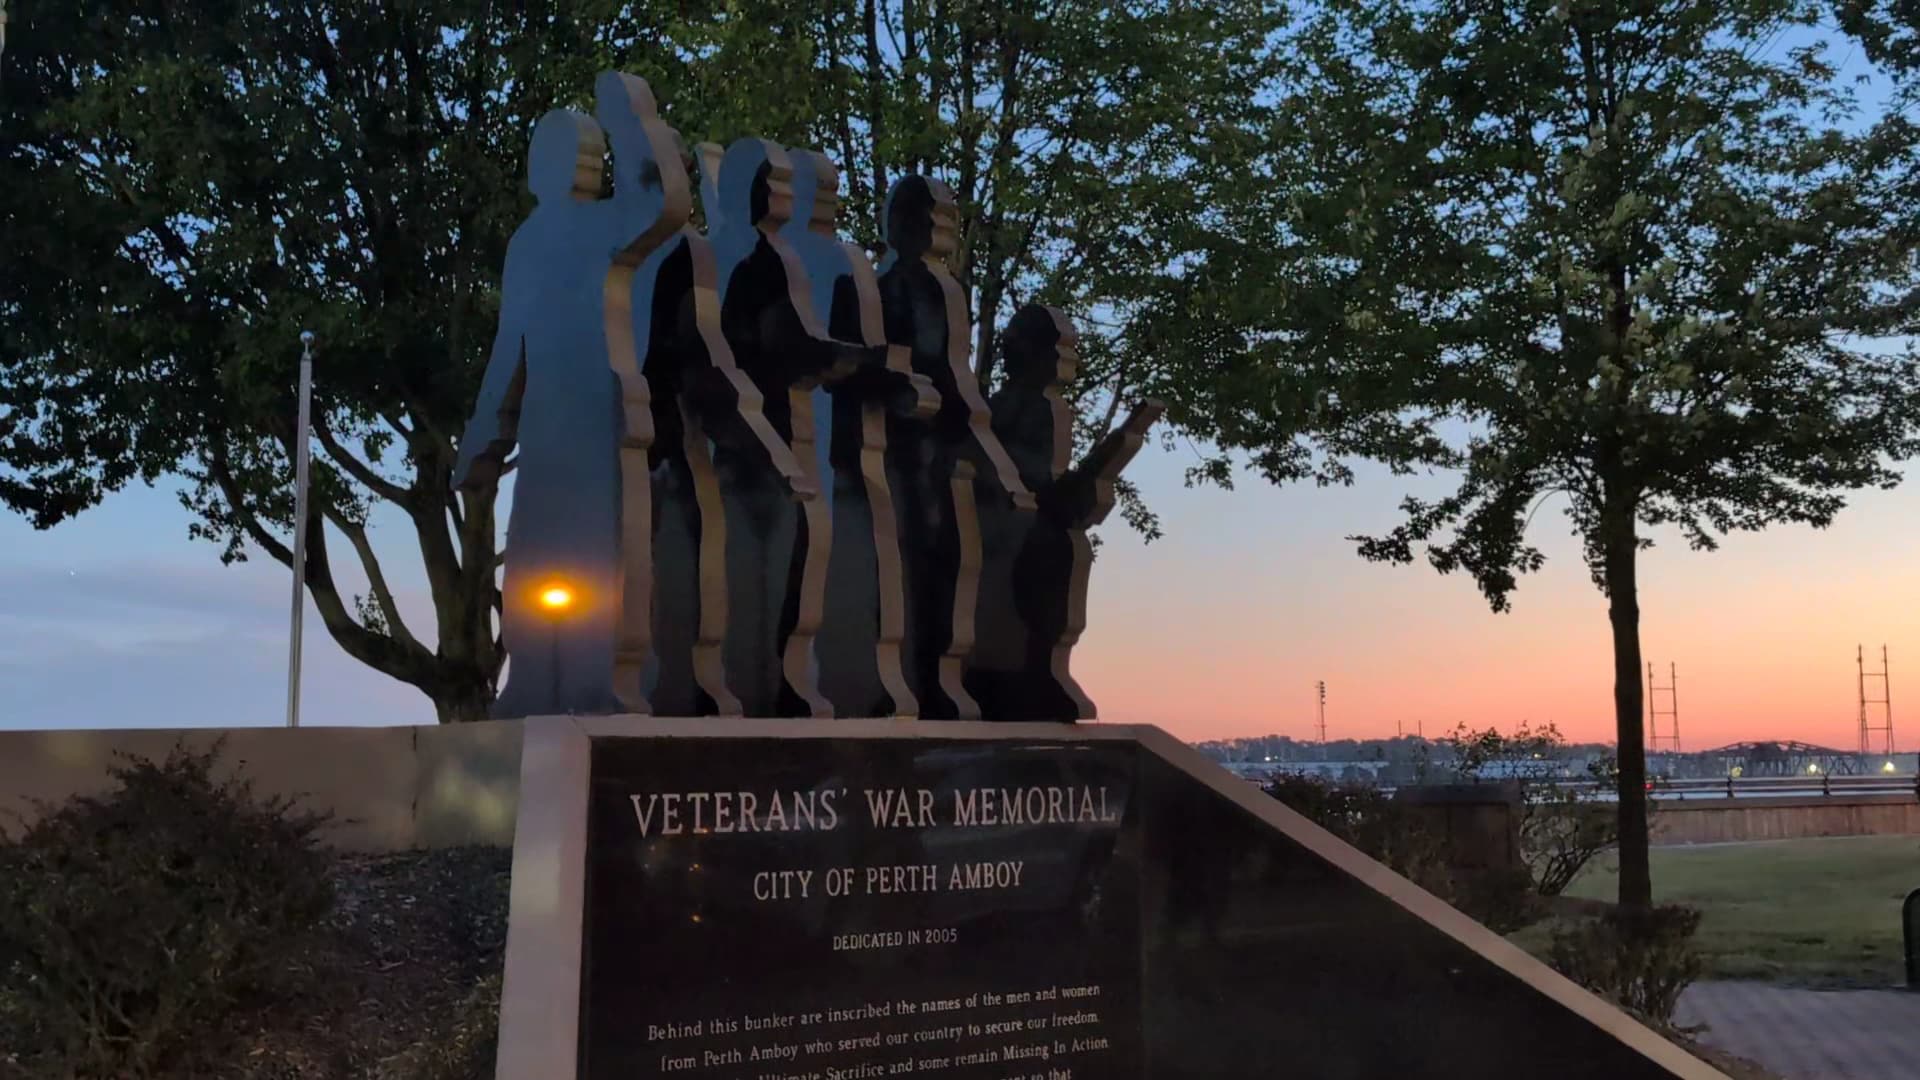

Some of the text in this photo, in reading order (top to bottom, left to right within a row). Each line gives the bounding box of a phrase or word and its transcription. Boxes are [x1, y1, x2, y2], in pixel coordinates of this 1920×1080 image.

[630, 786, 1115, 837] VETERANS' WAR MEMORIAL
[754, 861, 1023, 900] CITY OF PERTH AMBOY
[833, 929, 957, 950] DEDICATED IN 2005
[649, 986, 1100, 1040] Behind this bunker are inscribed the names of the men and women
[662, 1011, 1098, 1071] from Perth Amboy who served our country to secure our freedom
[826, 1063, 884, 1080] Sacrifice
[890, 1058, 912, 1074] and
[919, 1058, 949, 1070] some
[956, 1049, 997, 1066] remain
[1003, 1046, 1049, 1060] Missing
[1054, 1040, 1066, 1054] In
[1072, 1038, 1108, 1052] Action
